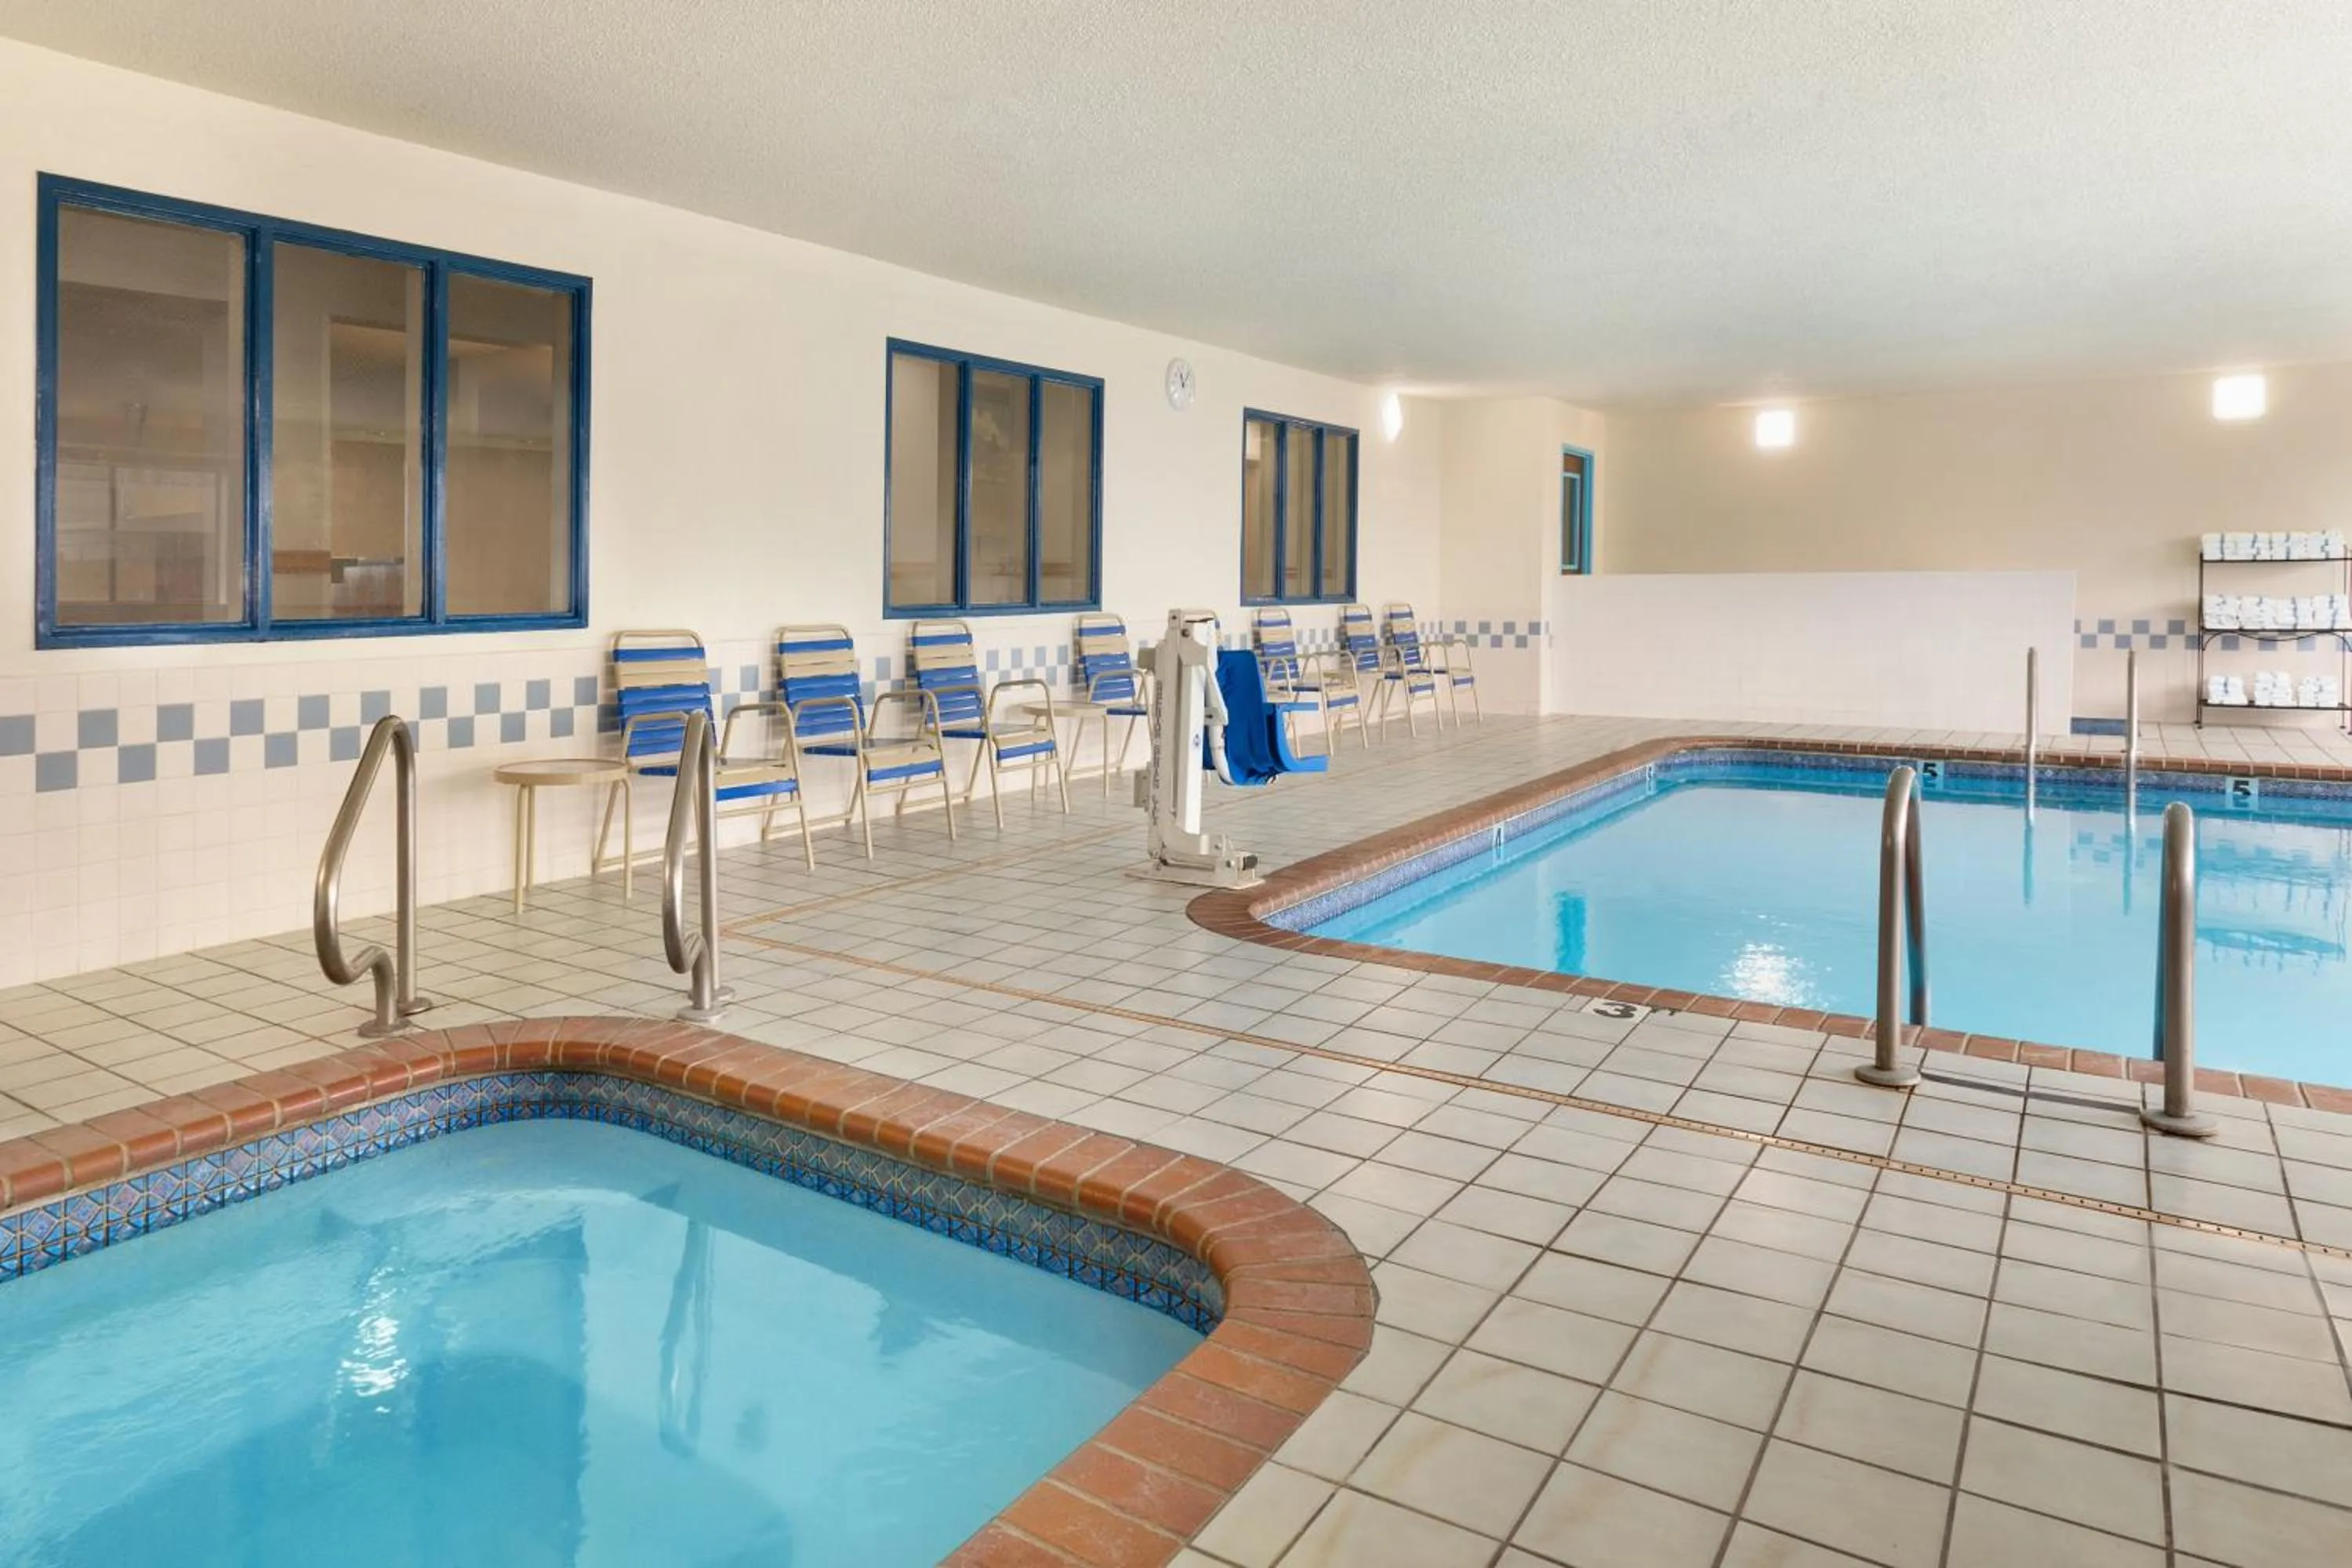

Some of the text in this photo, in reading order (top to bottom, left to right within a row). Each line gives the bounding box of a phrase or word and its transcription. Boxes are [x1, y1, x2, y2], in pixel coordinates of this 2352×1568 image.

[1922, 761, 1938, 778] 5
[2232, 779, 2252, 797] 5
[1593, 1002, 1638, 1018] 3
